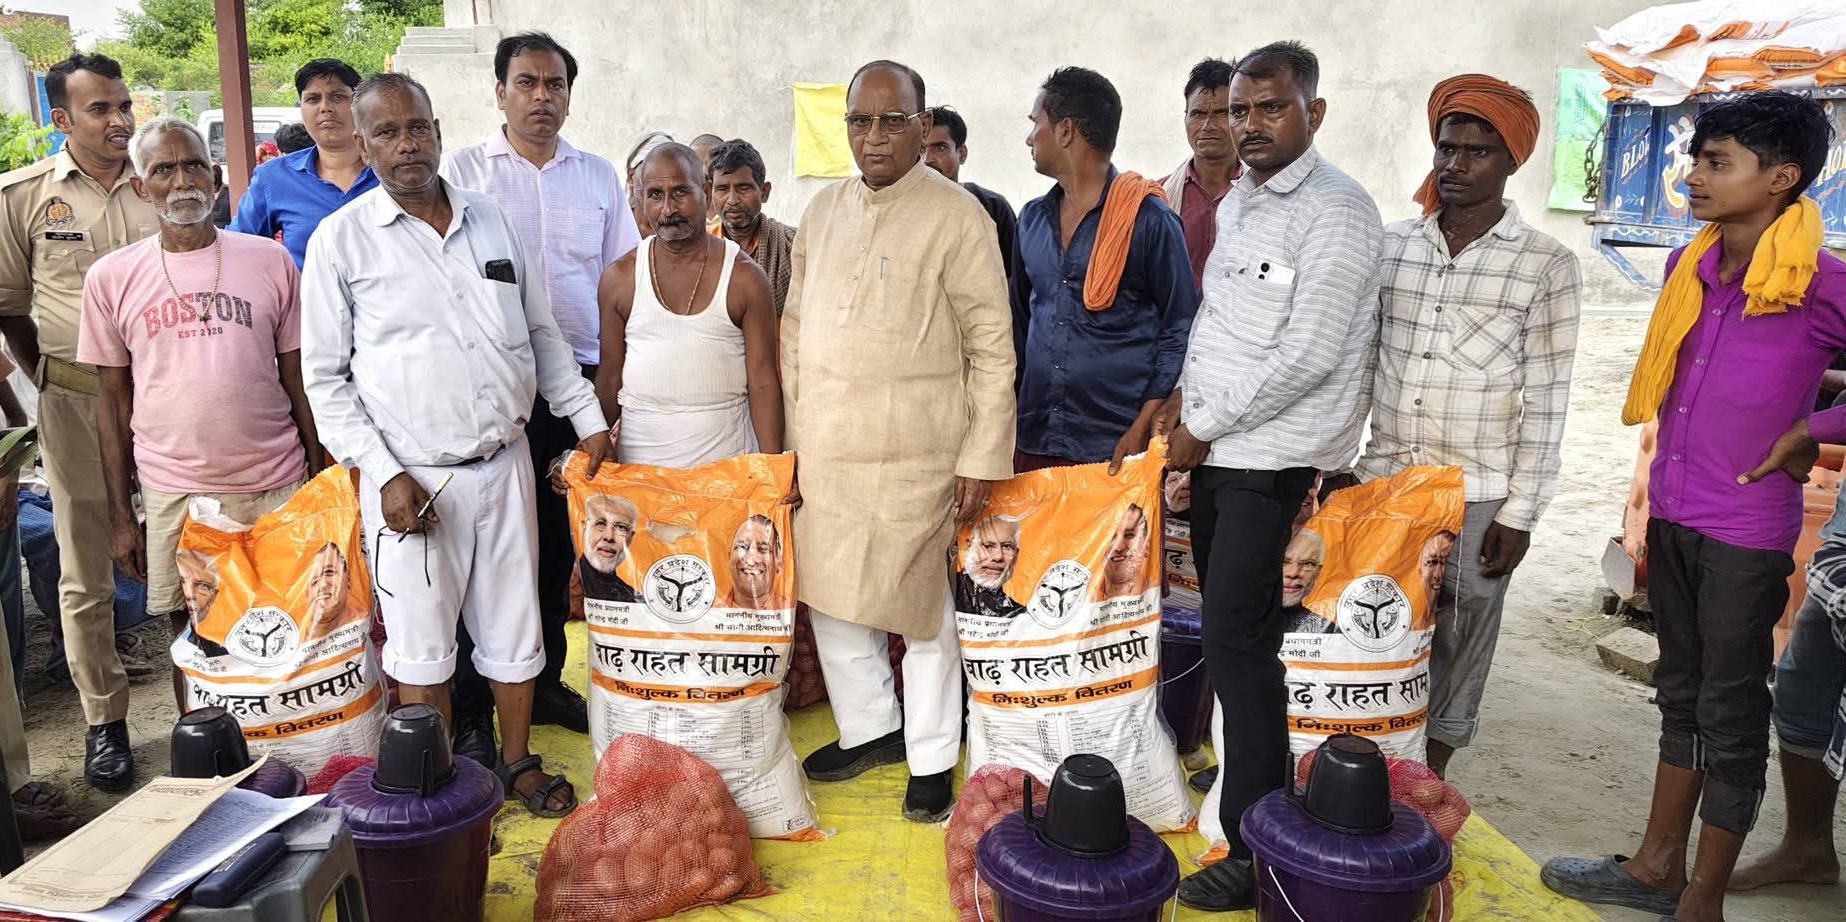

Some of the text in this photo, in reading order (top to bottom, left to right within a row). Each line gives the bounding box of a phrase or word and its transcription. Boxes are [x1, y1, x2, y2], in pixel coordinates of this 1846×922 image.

[143, 292, 253, 338] BOSTON
[178, 329, 197, 340] EST
[630, 648, 691, 677] राहत
[697, 645, 780, 678] सामग्री
[963, 630, 1150, 686] बाढ़ राहत सामग्री
[1309, 649, 1321, 659] जी
[278, 660, 366, 711] सामग्री
[1075, 679, 1133, 700] वितरण
[1324, 682, 1394, 711] राहत
[274, 711, 344, 736] वितरण
